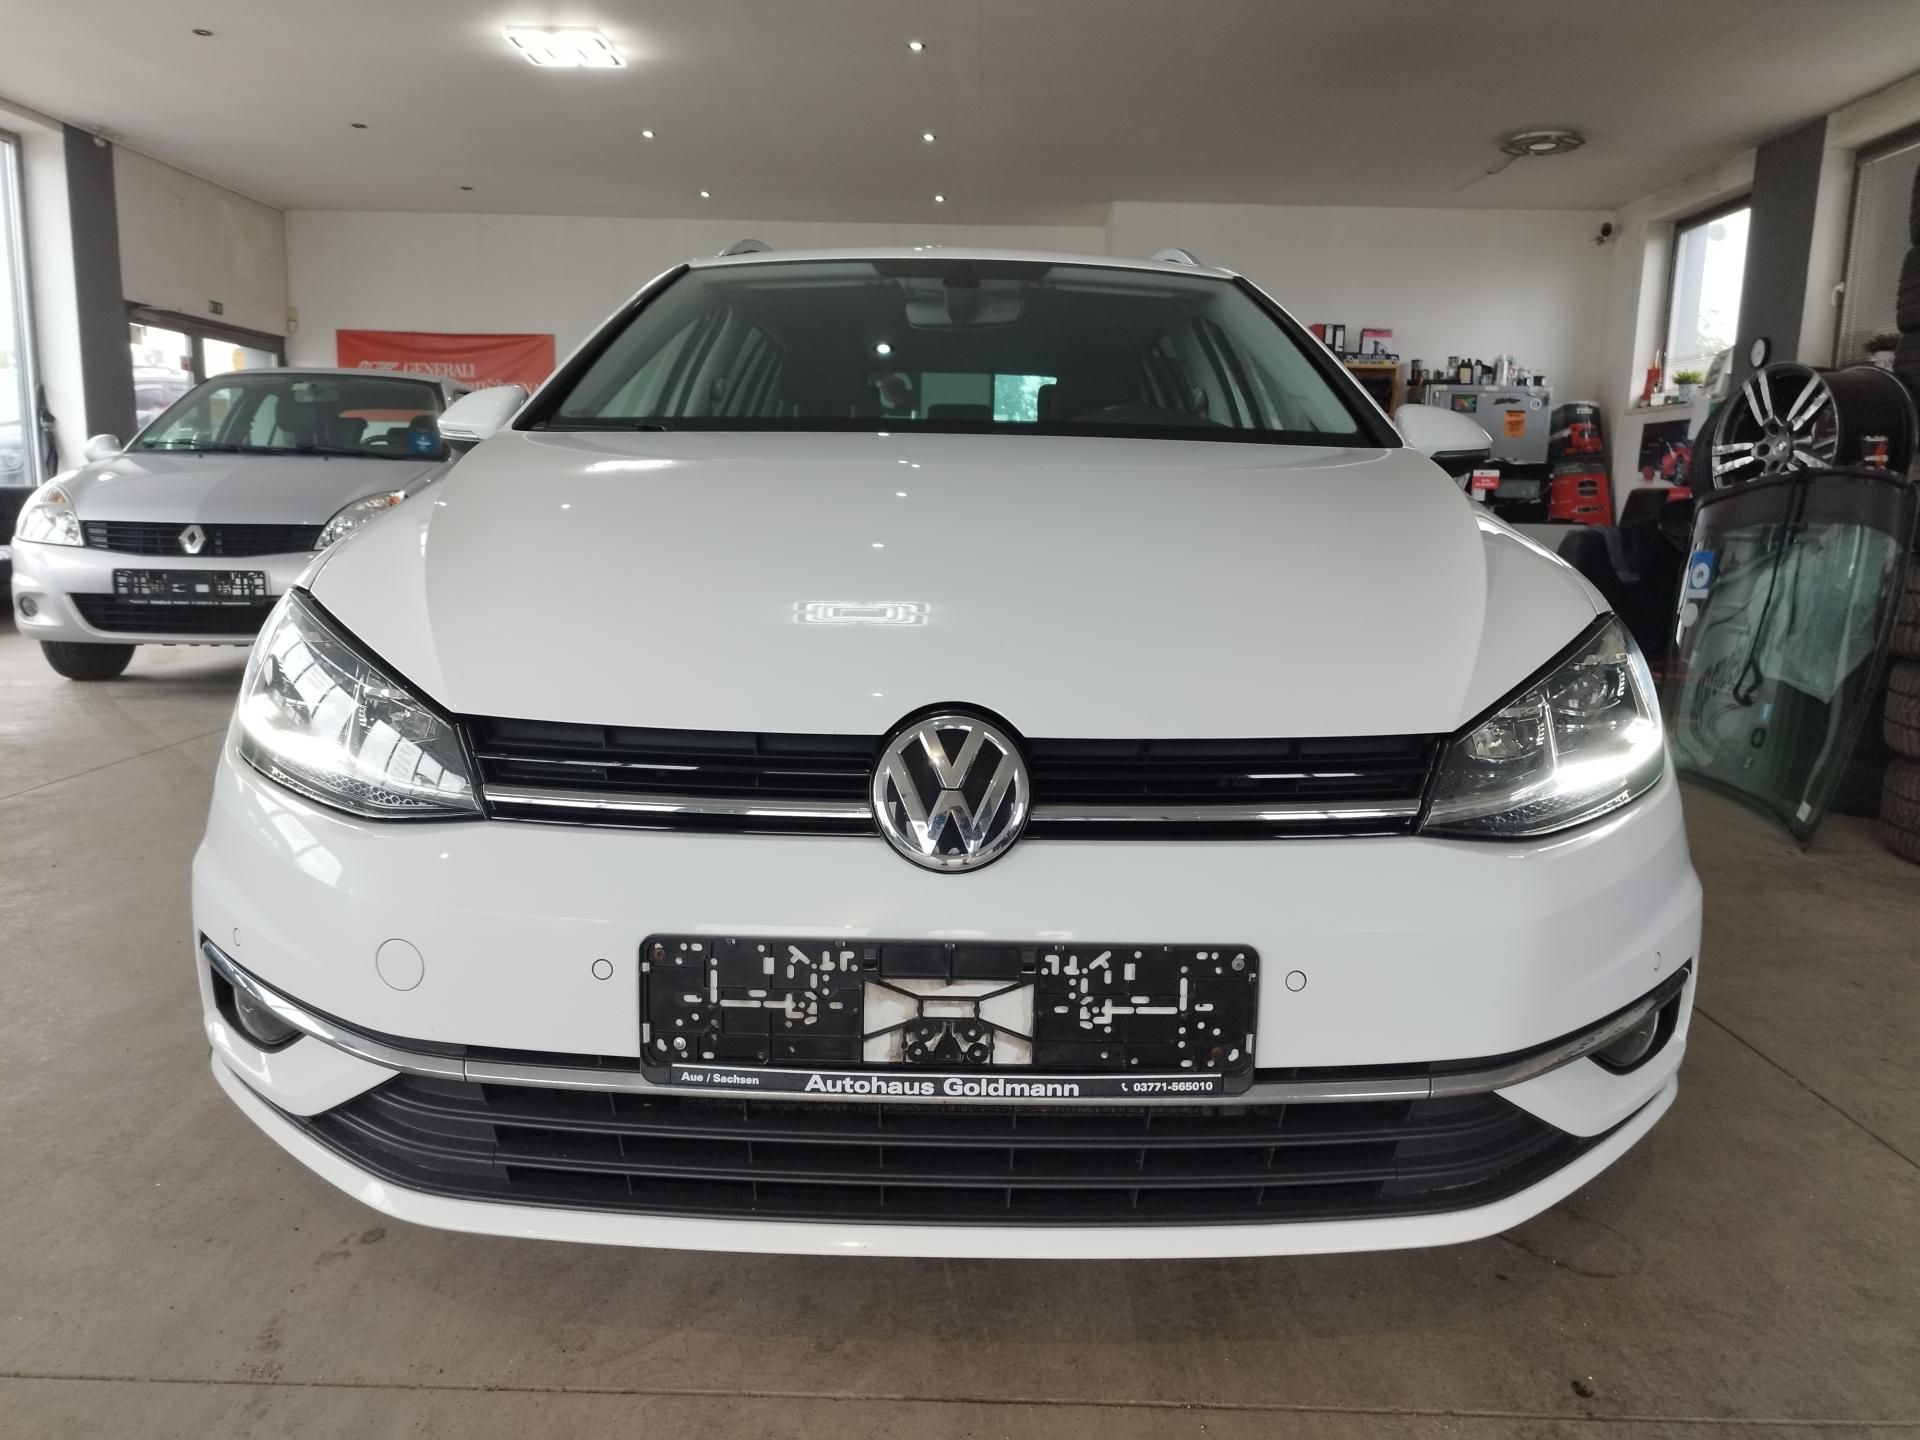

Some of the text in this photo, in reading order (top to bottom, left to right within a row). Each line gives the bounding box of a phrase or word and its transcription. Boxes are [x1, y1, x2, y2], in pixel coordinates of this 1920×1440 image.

[878, 717, 1021, 862] VW
[681, 1071, 760, 1086] Aue / Sachsen
[804, 1074, 1080, 1097] Autohaus Goldmann
[1133, 1081, 1214, 1094] 03771-565010
